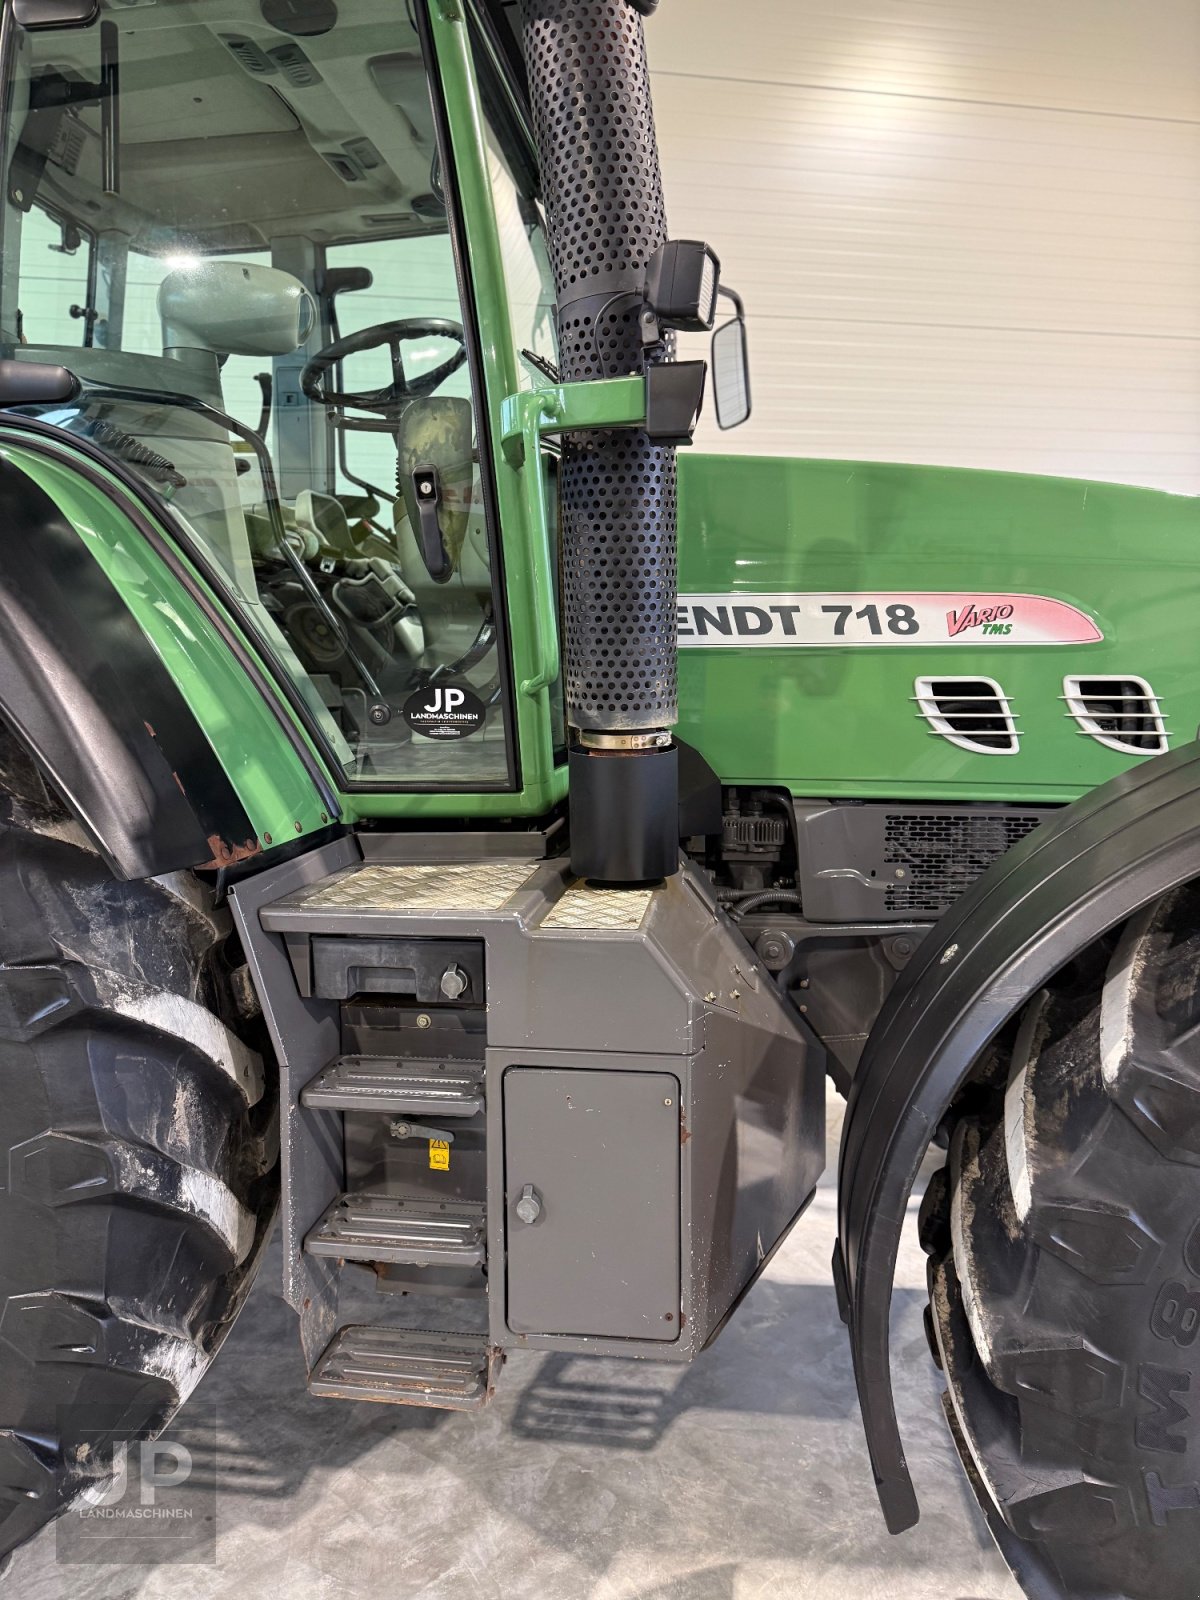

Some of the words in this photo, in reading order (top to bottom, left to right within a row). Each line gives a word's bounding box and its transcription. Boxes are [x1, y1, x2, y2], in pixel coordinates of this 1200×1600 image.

[821, 604, 920, 635] 718
[982, 624, 1013, 635] TMS
[424, 688, 465, 712] JP
